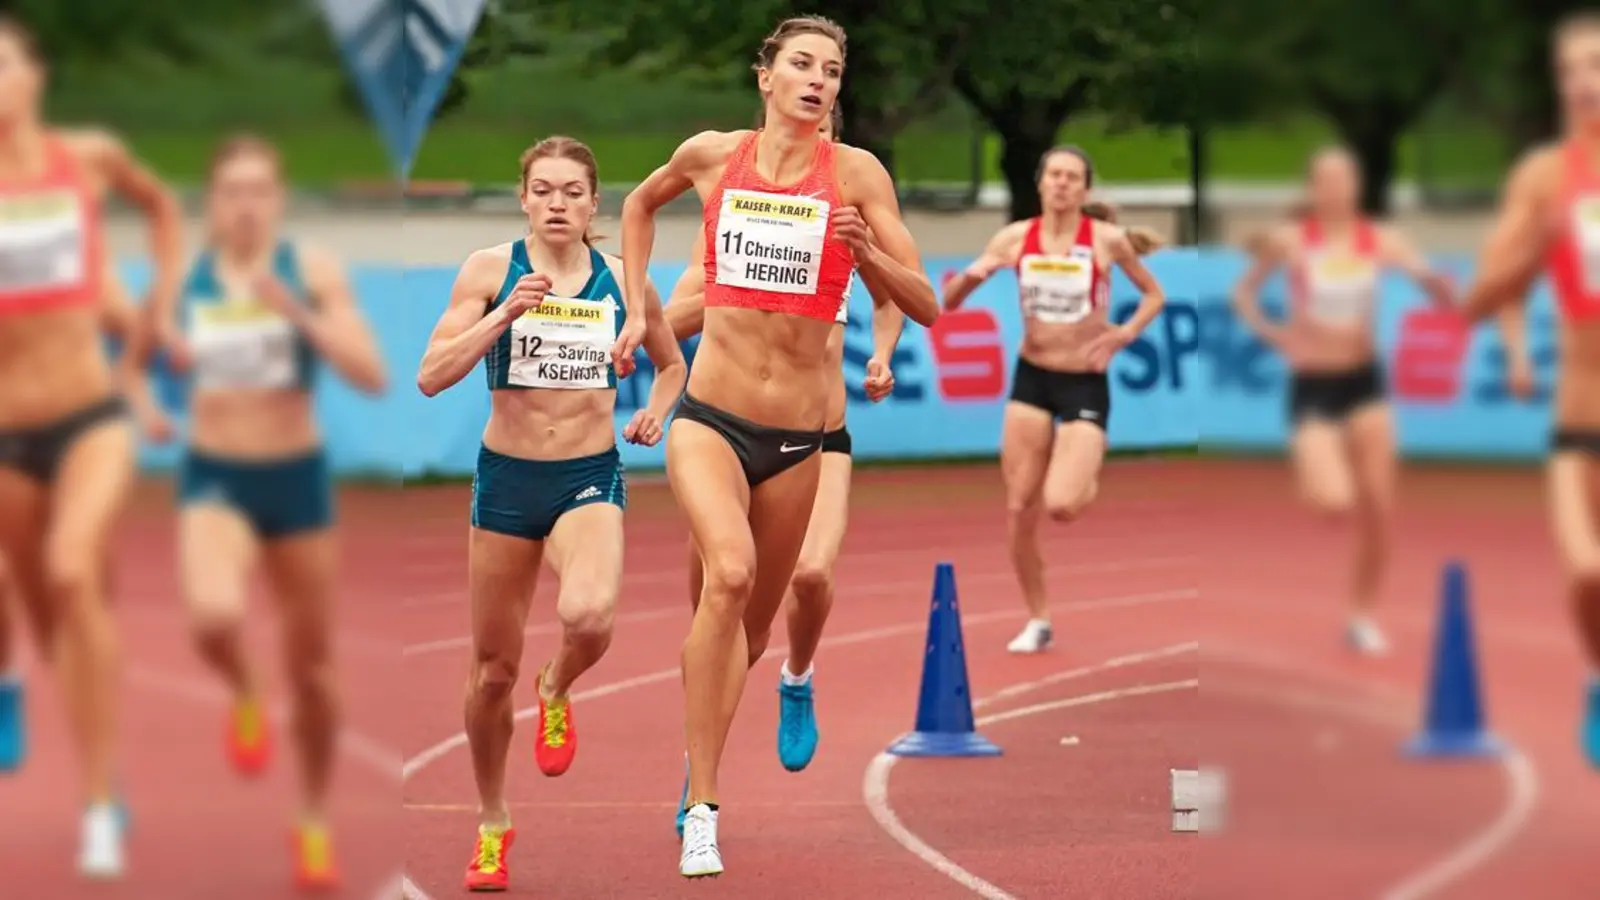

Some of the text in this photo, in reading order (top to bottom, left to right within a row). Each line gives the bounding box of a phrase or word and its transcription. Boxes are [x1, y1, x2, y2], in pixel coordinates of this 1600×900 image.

[722, 230, 811, 263] 11 Christina
[745, 262, 808, 285] HERING
[518, 335, 606, 363] 12 Savina
